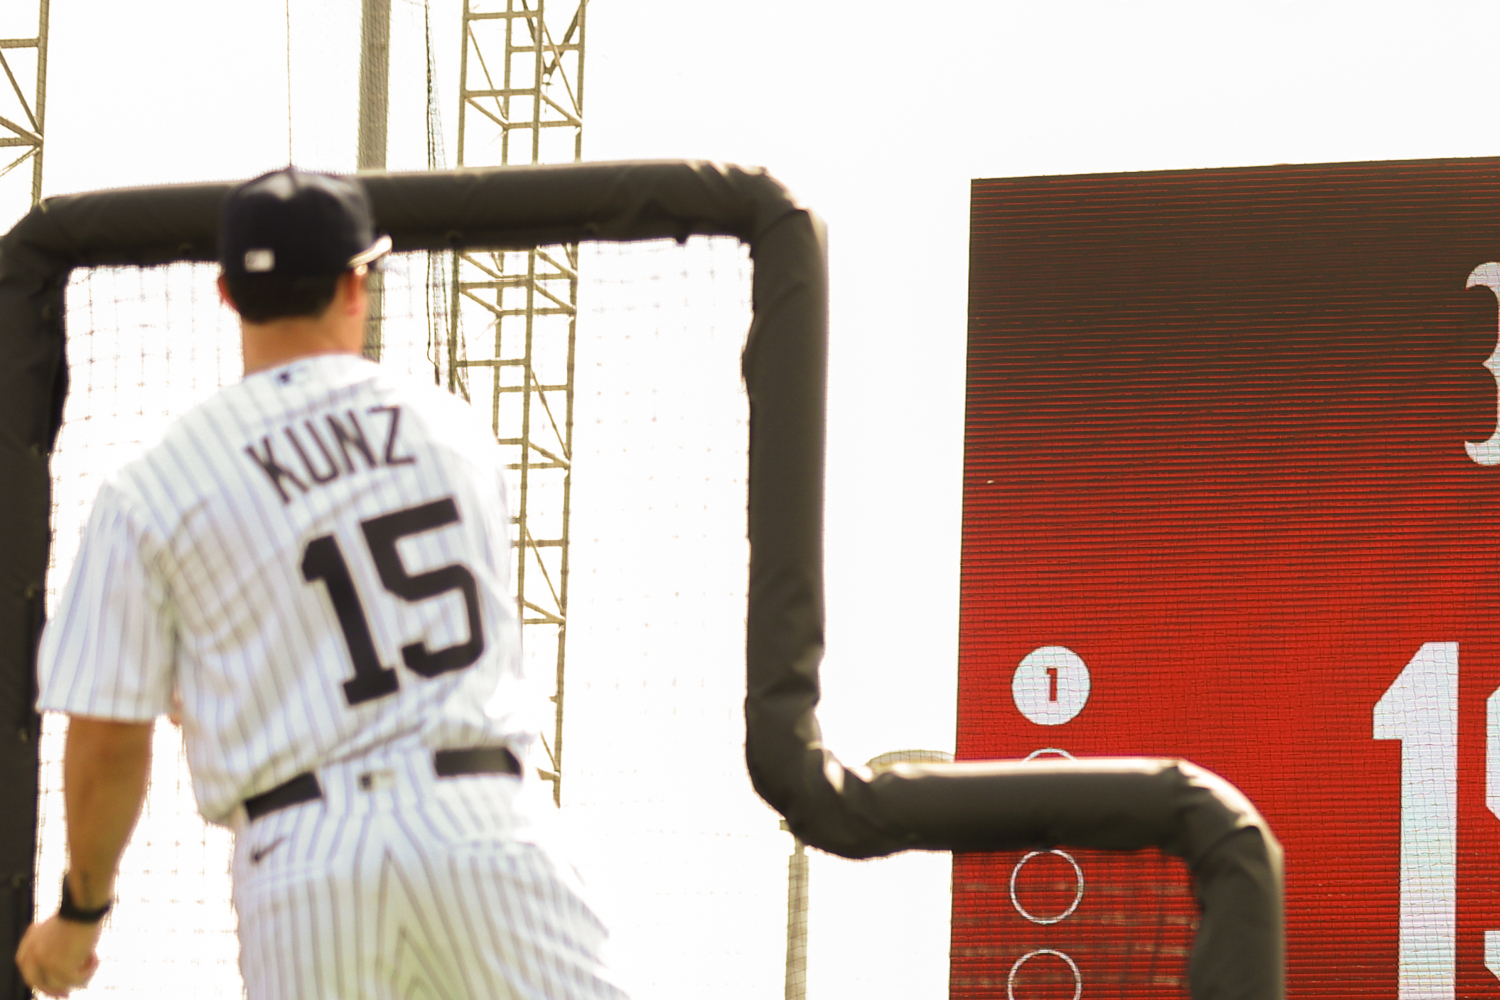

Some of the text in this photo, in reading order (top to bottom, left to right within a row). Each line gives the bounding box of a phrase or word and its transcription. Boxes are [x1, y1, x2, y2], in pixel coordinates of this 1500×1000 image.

[245, 404, 418, 505] KUNZ
[301, 494, 487, 706] 15
[1045, 666, 1058, 703] 1
